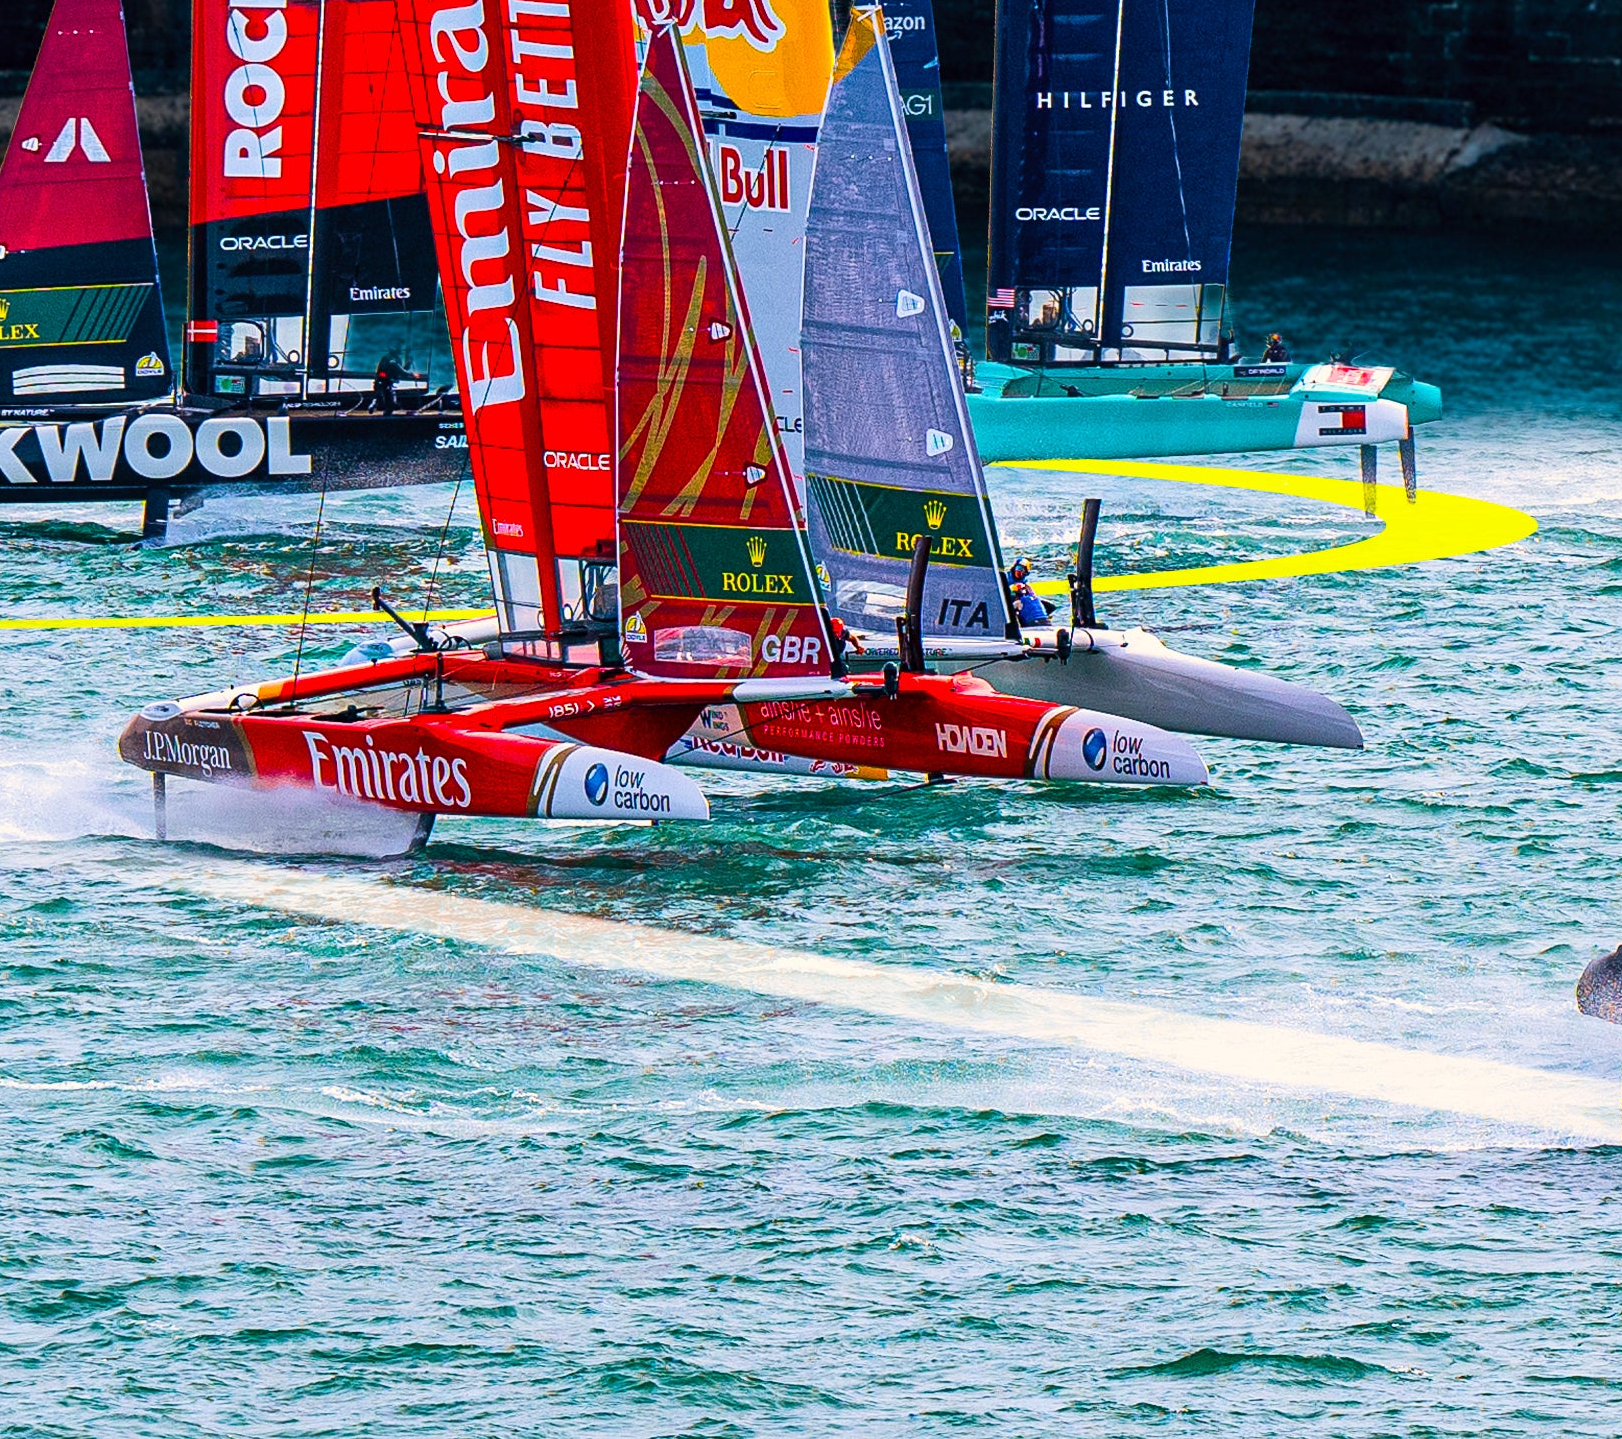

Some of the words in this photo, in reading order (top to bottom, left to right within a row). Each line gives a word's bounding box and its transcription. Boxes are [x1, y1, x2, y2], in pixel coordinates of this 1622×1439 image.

[884, 15, 925, 30] azon
[1037, 89, 1200, 108] HILFIGER
[720, 146, 791, 213] Bull
[1015, 207, 1100, 221] ORACLE
[220, 234, 308, 250] ORACLE
[526, 187, 597, 310] FLY
[1142, 258, 1202, 273] Emirates
[350, 287, 410, 301] Emirates
[1, 409, 13, 417] BY
[435, 435, 469, 448] SAIL
[544, 451, 610, 471] ORACLE
[722, 572, 794, 594] ROLEX
[938, 599, 991, 629] ITA
[762, 635, 822, 664] GBR
[865, 647, 899, 656] OWERED
[829, 701, 882, 730] ainslie
[764, 724, 834, 743] PERFORMANCE
[839, 733, 885, 747] POWDERS
[935, 723, 1007, 757] HOWDEN
[1113, 730, 1143, 753] low
[143, 730, 231, 776] J.P.Morgan
[303, 730, 472, 809] Emirates
[614, 765, 644, 789] low
[1113, 754, 1170, 779] carbon
[614, 792, 671, 813] carbon
